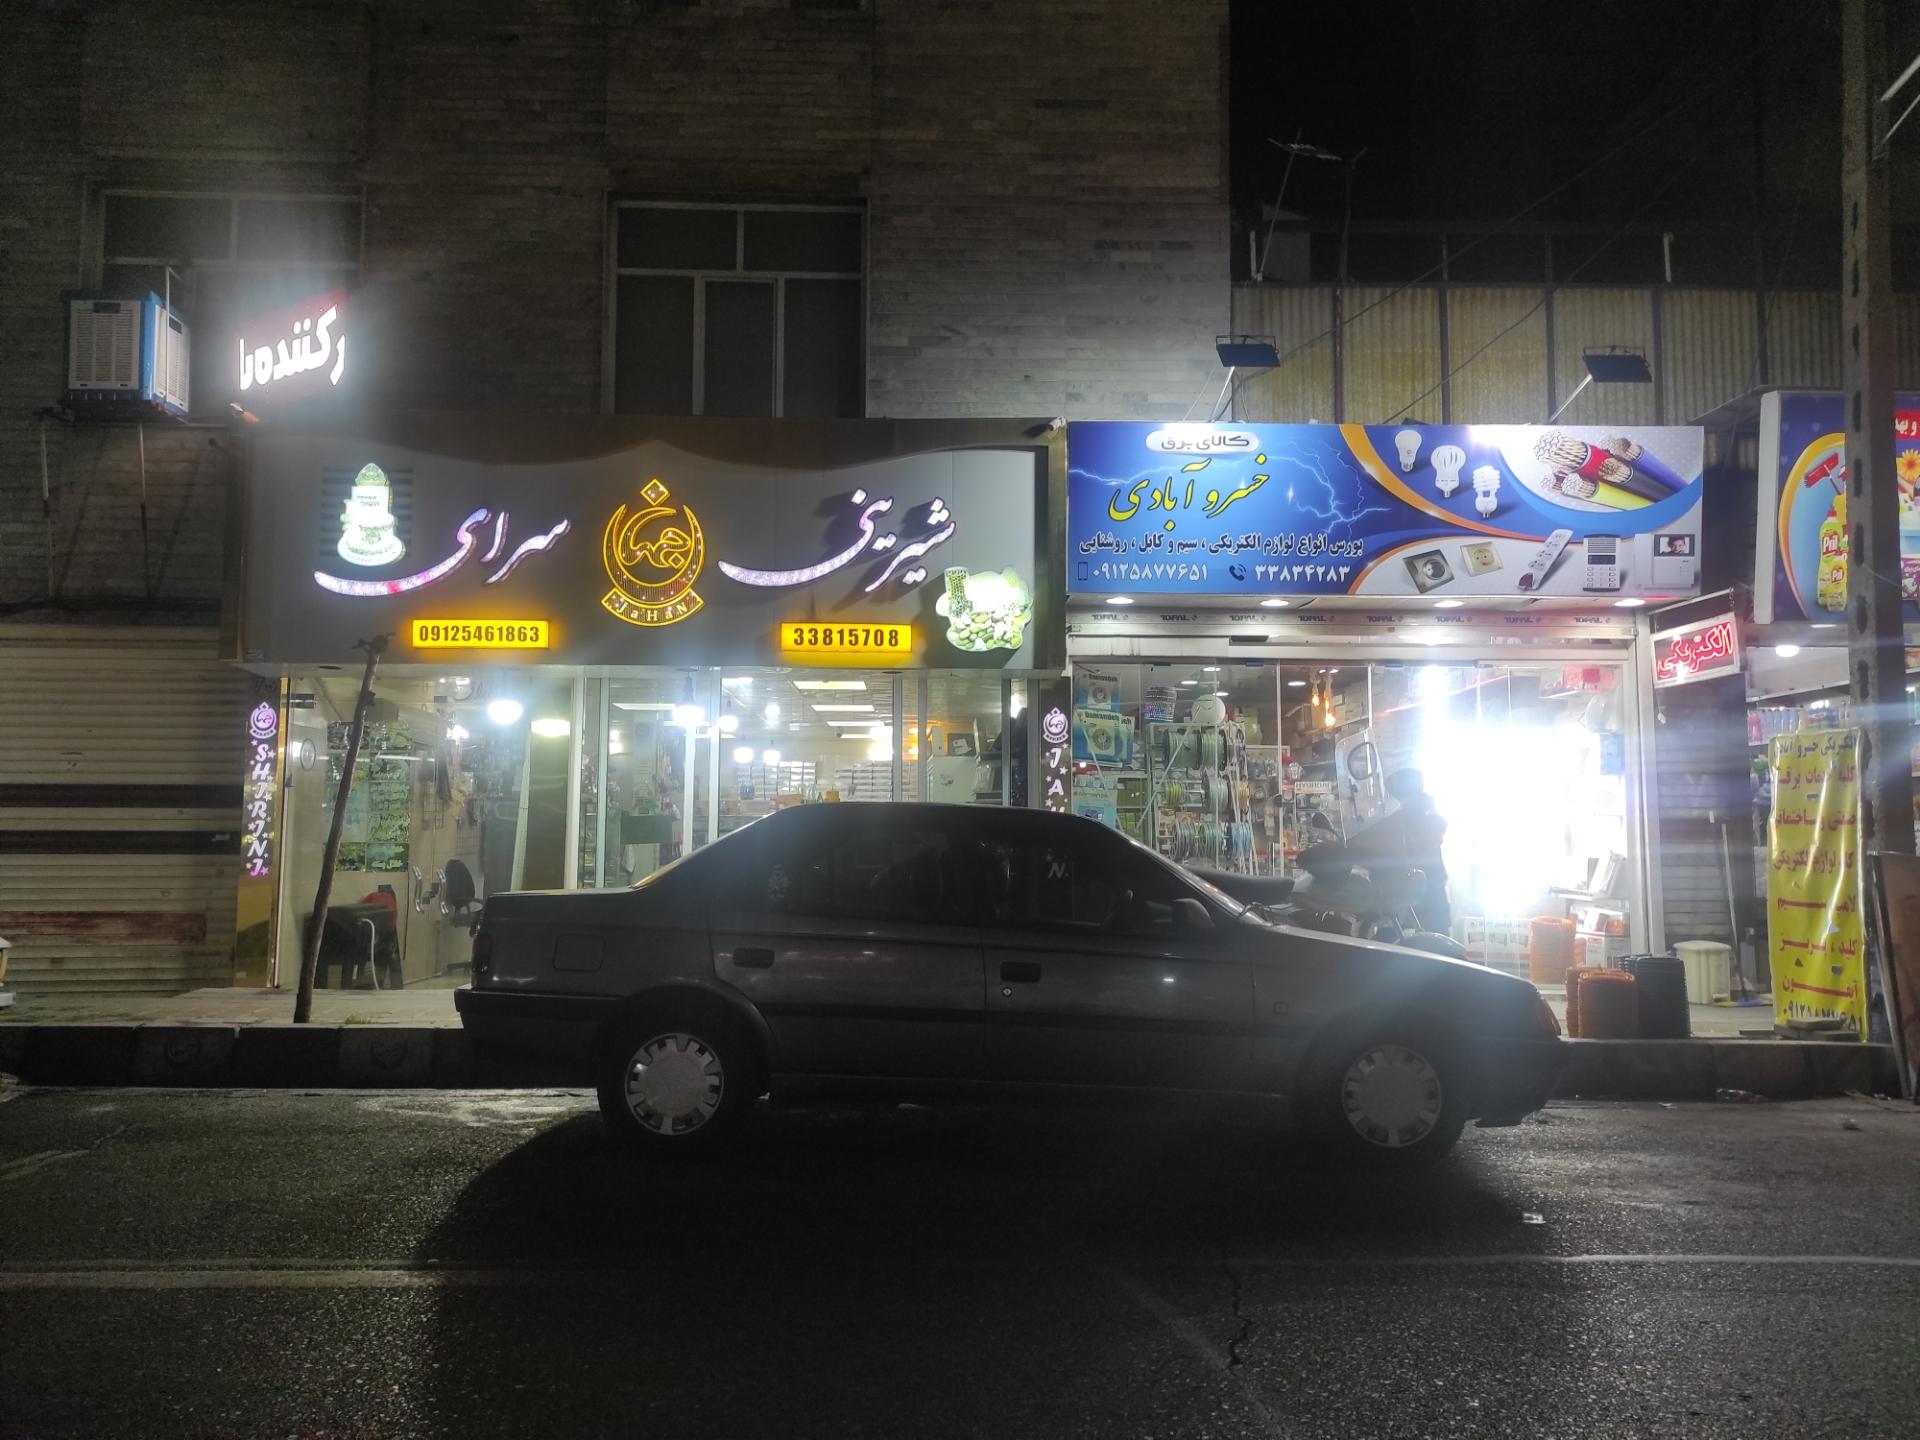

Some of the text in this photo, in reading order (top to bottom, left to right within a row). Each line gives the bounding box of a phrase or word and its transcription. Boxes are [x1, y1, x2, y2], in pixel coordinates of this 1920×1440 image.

[1160, 433, 1250, 450] کالای برق
[1107, 452, 1270, 531] خسرو آبادی
[313, 488, 956, 597] شیرینی سرای
[1079, 530, 1128, 555] روشنایی
[1166, 538, 1174, 555] و
[1176, 538, 1198, 554] سیم
[1263, 532, 1295, 556] لوازم
[1297, 533, 1328, 556] انواع
[1328, 538, 1364, 557] بورس
[1823, 534, 1838, 553] Pril
[1092, 561, 1208, 581] ۰۹۱۲۵۸۷۷۶۵۱
[1254, 564, 1351, 583] ۳۳۸۳۴۲۸۳
[419, 624, 540, 643] 09125461863
[793, 628, 899, 648] 33815708
[1657, 623, 1733, 679] الکتریکی
